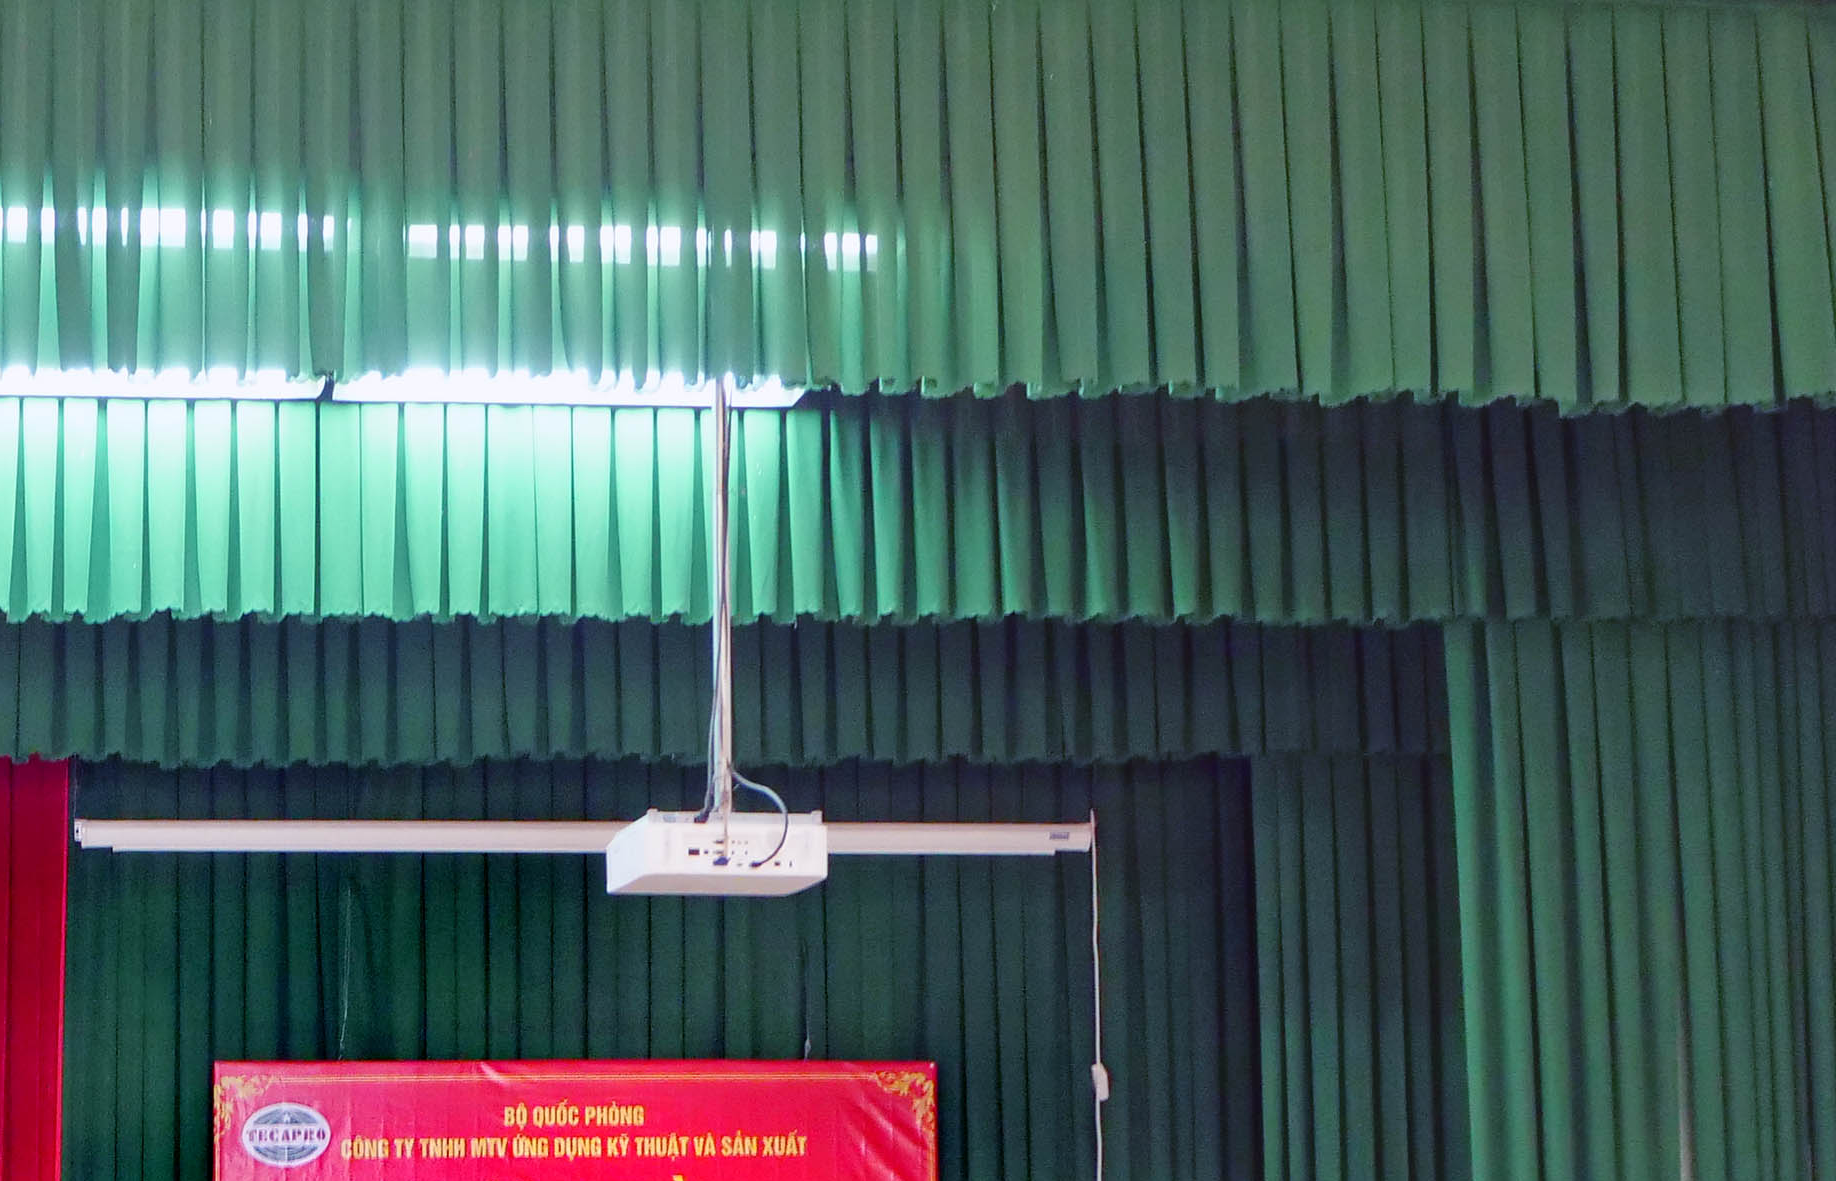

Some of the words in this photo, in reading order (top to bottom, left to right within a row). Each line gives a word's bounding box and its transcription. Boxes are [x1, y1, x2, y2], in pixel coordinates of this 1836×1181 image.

[504, 1102, 527, 1129] BỘ
[533, 1099, 579, 1128] QUỐC
[585, 1101, 645, 1126] PHÒNG
[246, 1127, 326, 1142] TECAPRO
[340, 1135, 390, 1160] CÔNG
[393, 1138, 414, 1159] TY
[419, 1138, 465, 1158] TNHH
[470, 1137, 507, 1158] MTV
[512, 1133, 548, 1158] ỨNG
[554, 1136, 602, 1161] DỤNG
[607, 1133, 630, 1157] KỸ
[634, 1133, 689, 1161] THUẬT
[694, 1132, 716, 1157] VÀ
[721, 1130, 757, 1157] SẢN
[762, 1130, 807, 1157] XUẤT
